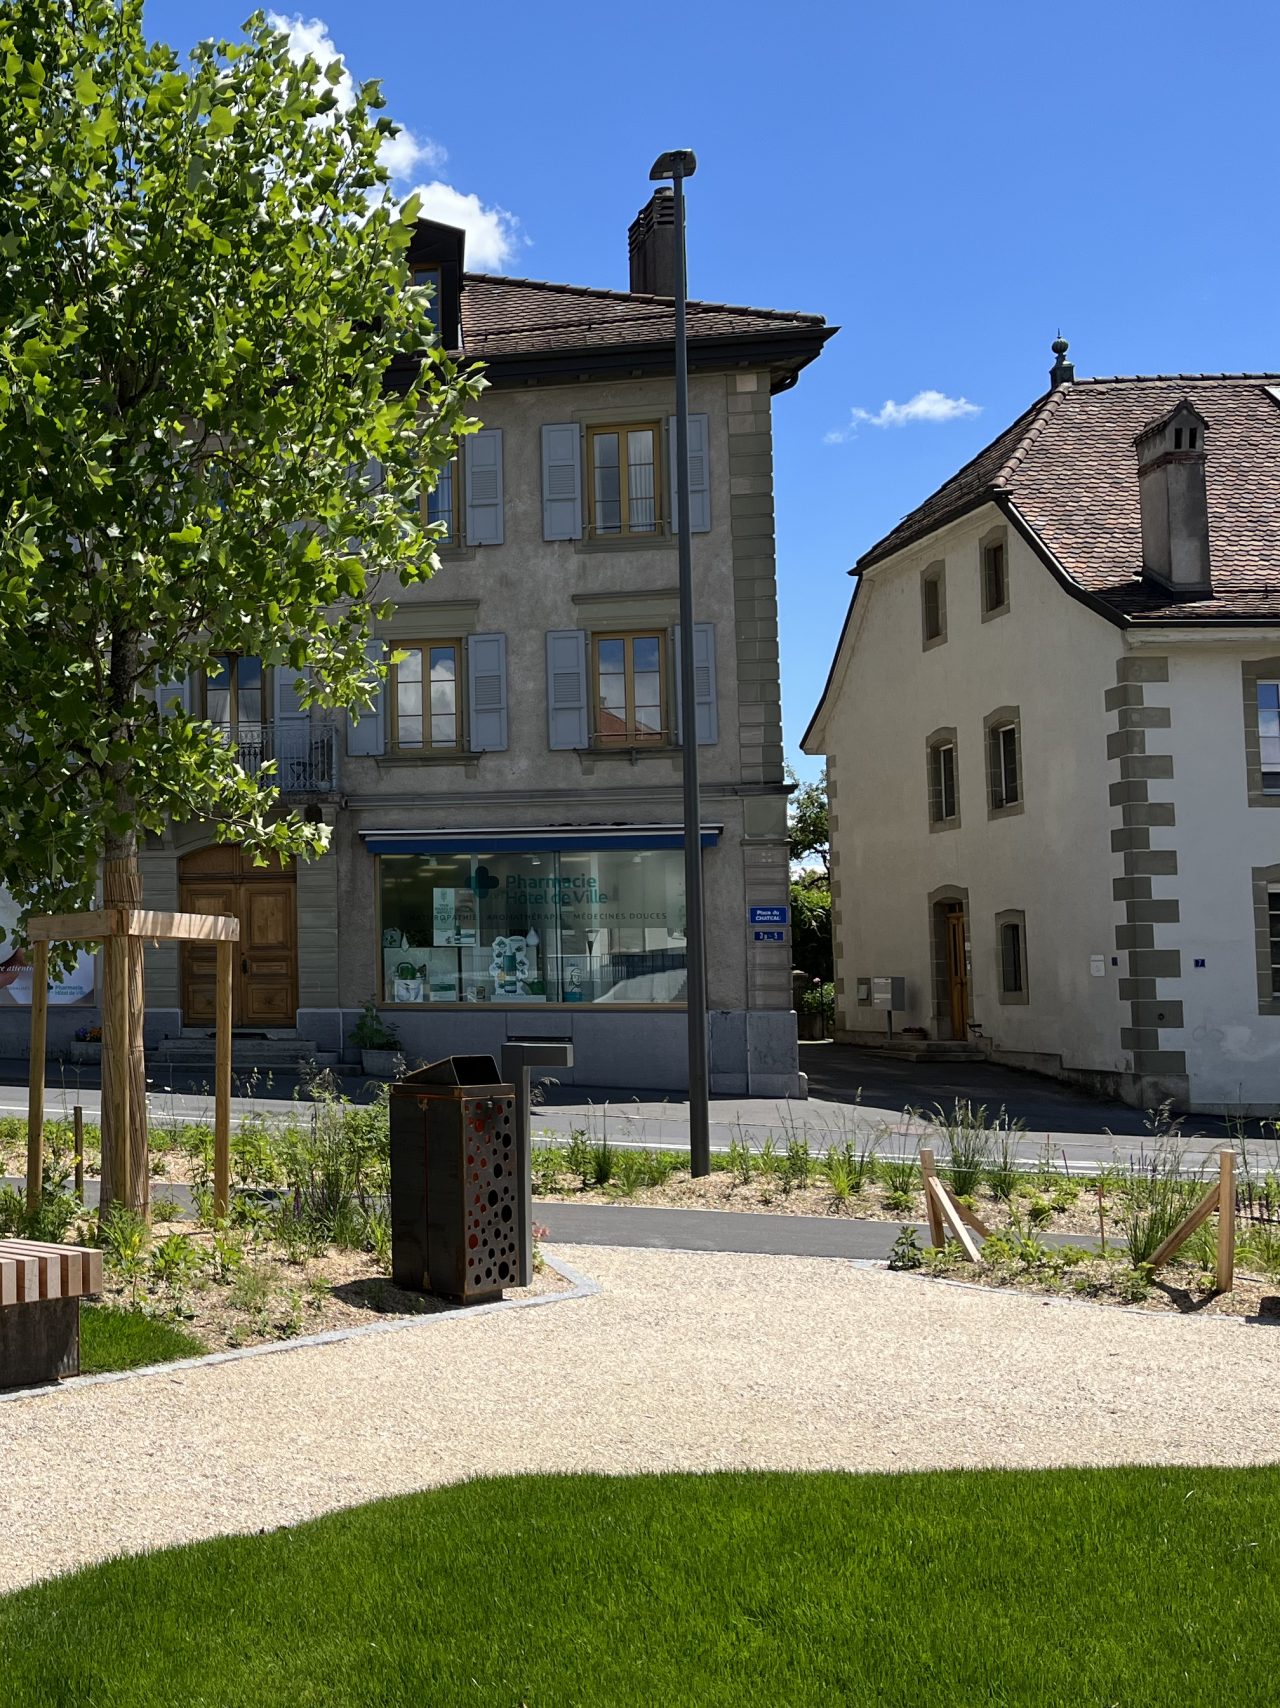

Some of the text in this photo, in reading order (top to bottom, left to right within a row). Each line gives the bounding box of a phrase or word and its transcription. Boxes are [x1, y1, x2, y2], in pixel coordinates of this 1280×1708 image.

[505, 874, 597, 889] Pharmacie
[505, 889, 609, 905] Hôtel de Ville
[574, 911, 626, 920] MÉDECINES
[629, 912, 668, 920] DOUCES
